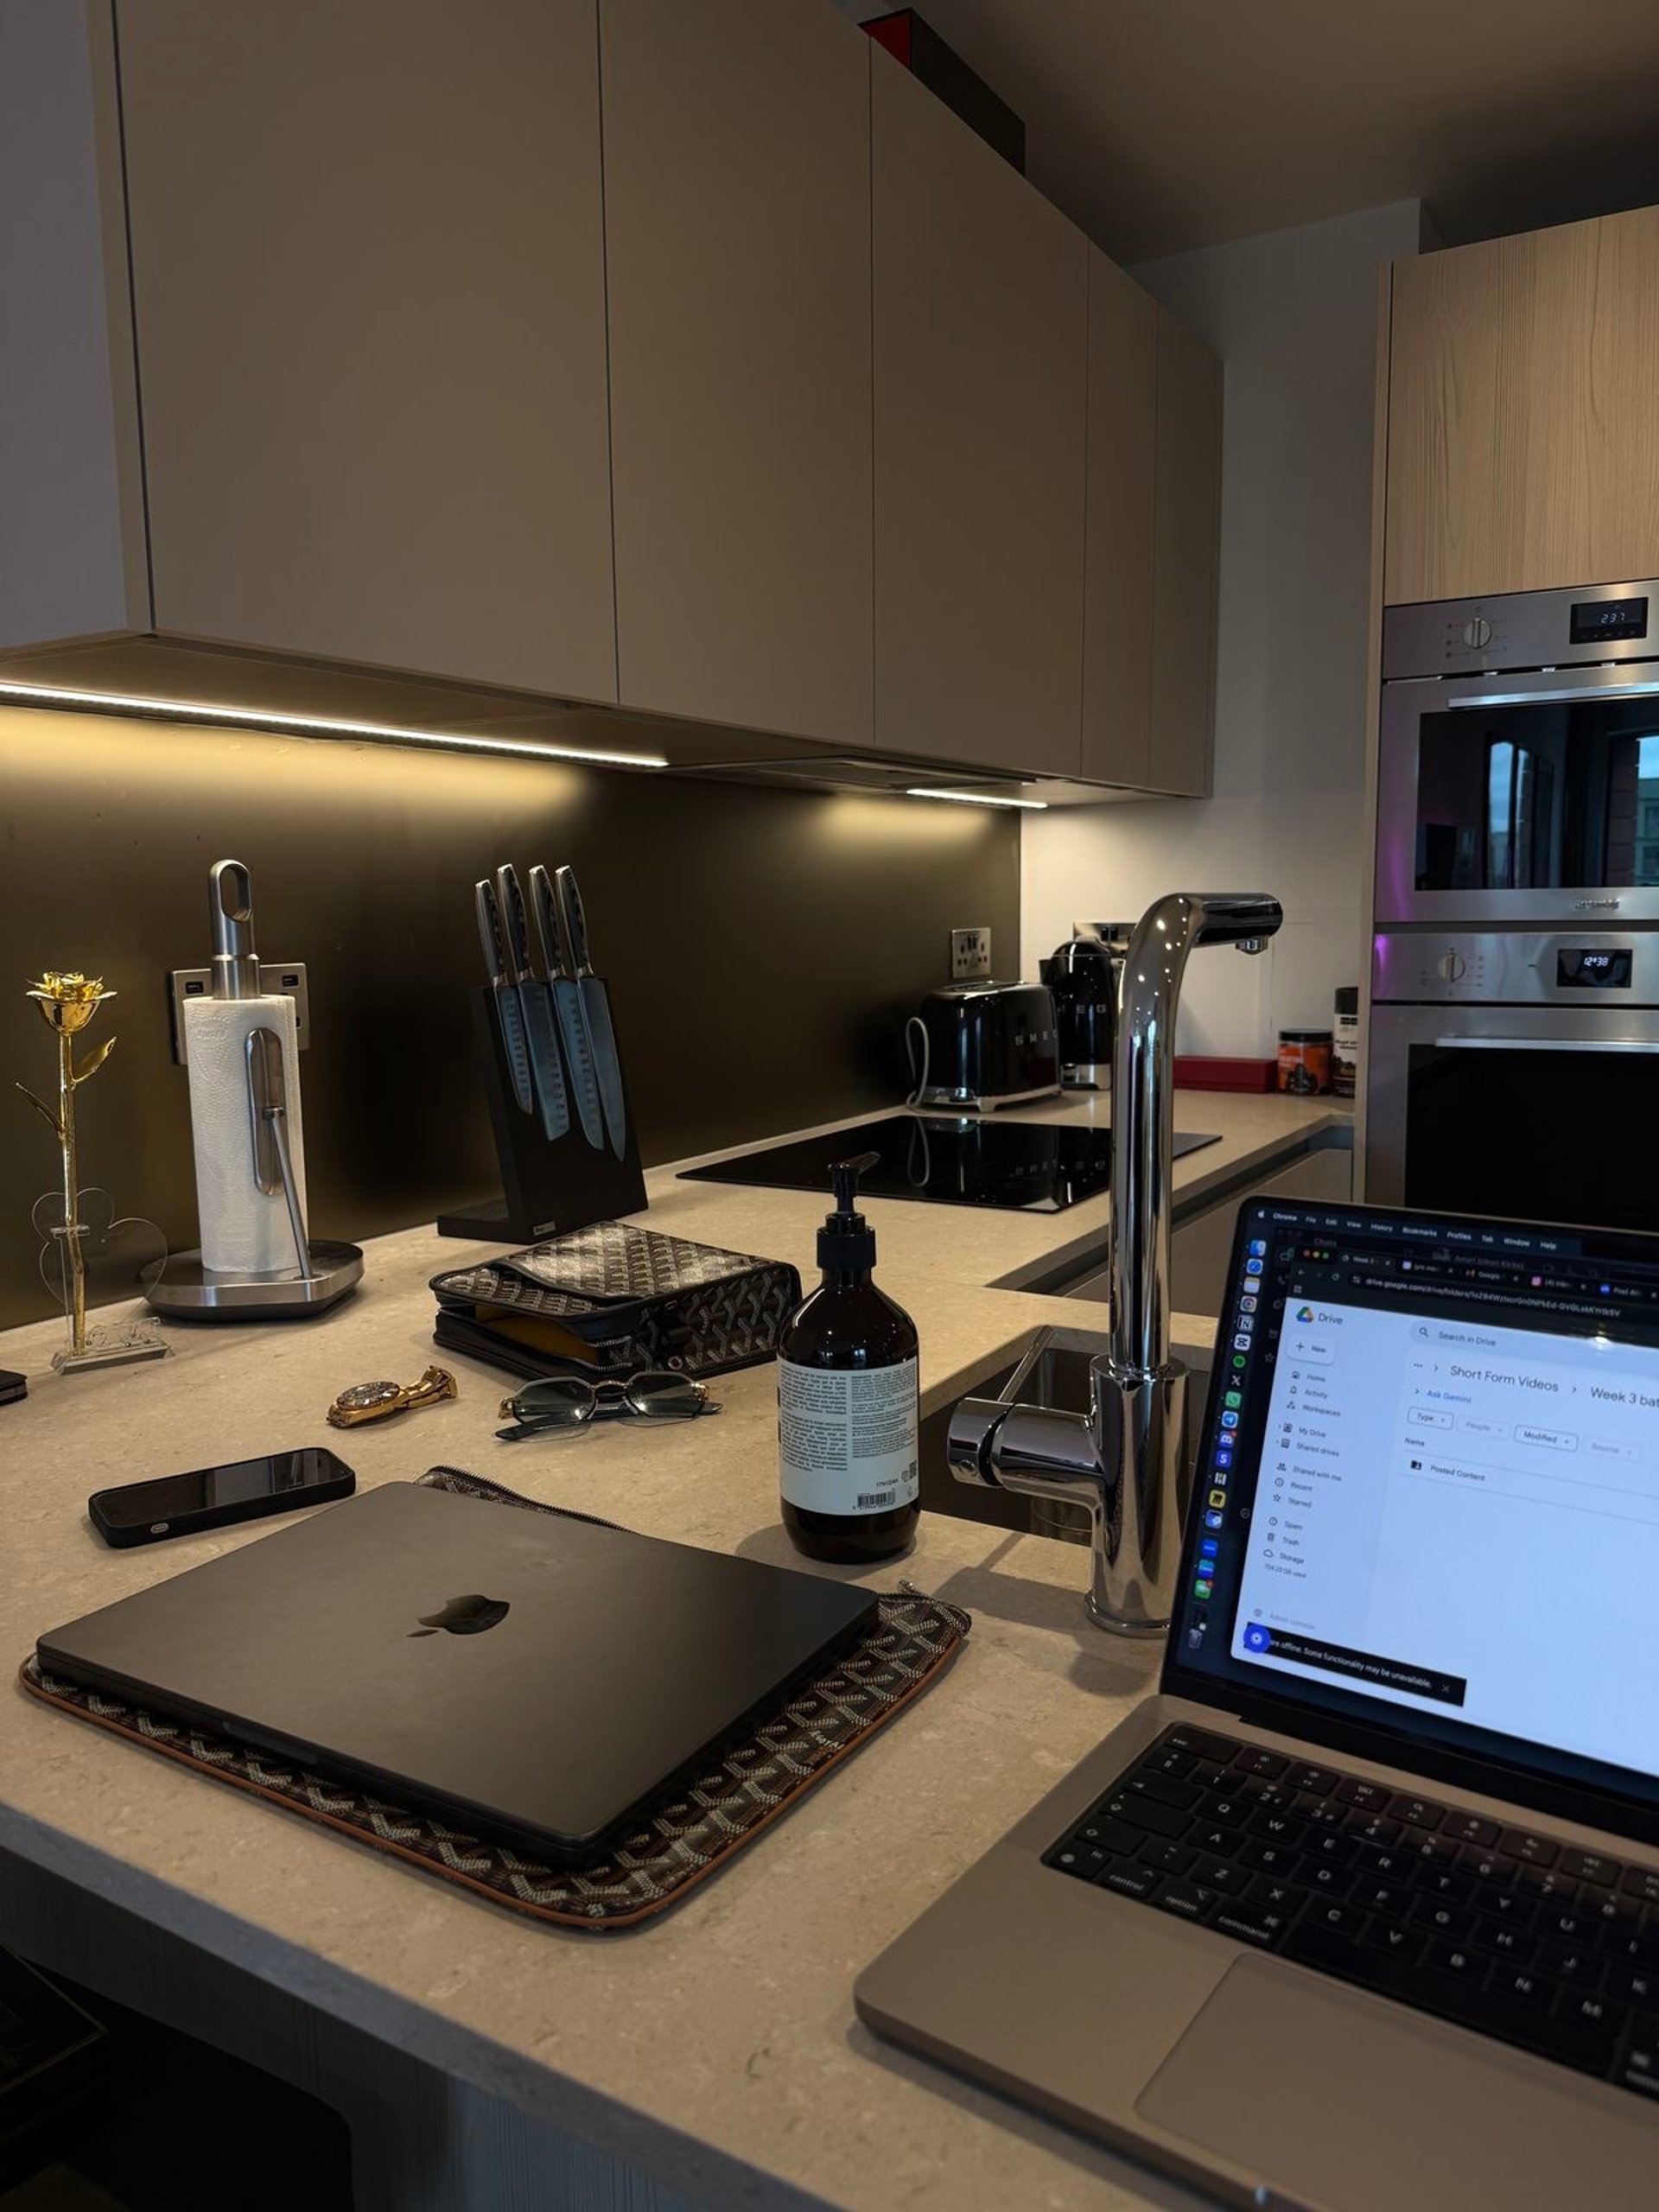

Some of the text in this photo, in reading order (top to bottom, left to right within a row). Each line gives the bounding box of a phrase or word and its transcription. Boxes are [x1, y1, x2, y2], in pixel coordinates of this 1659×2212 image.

[1273, 1212, 1297, 1222] Chrome
[1346, 1220, 1362, 1229] View
[1370, 1223, 1394, 1233] History
[1402, 1226, 1438, 1236] Bookmarks
[1318, 1313, 1344, 1325] Drive
[1439, 1331, 1497, 1347] Search in Drive
[1306, 1374, 1326, 1383] Home
[1450, 1365, 1560, 1393] Short Form Videos
[1305, 1389, 1328, 1400] Activity
[1427, 1389, 1472, 1404] Ask Gemini
[1590, 1387, 1626, 1403] Week
[1629, 1393, 1637, 1404] 3
[1302, 1404, 1341, 1417] Workspaces
[1417, 1412, 1434, 1423] Type
[1299, 1427, 1326, 1438] My Drive
[1523, 1431, 1558, 1444] Modified
[1296, 1442, 1319, 1453] Shared
[1404, 1437, 1426, 1447] Name
[1293, 1465, 1315, 1477] Shared
[1430, 1465, 1485, 1482] Posted Content
[1304, 1647, 1323, 1660] Some
[1324, 1652, 1365, 1671] functionality
[1366, 1664, 1381, 1676] may
[1381, 1668, 1390, 1677] be
[1109, 1874, 1145, 1891] control
